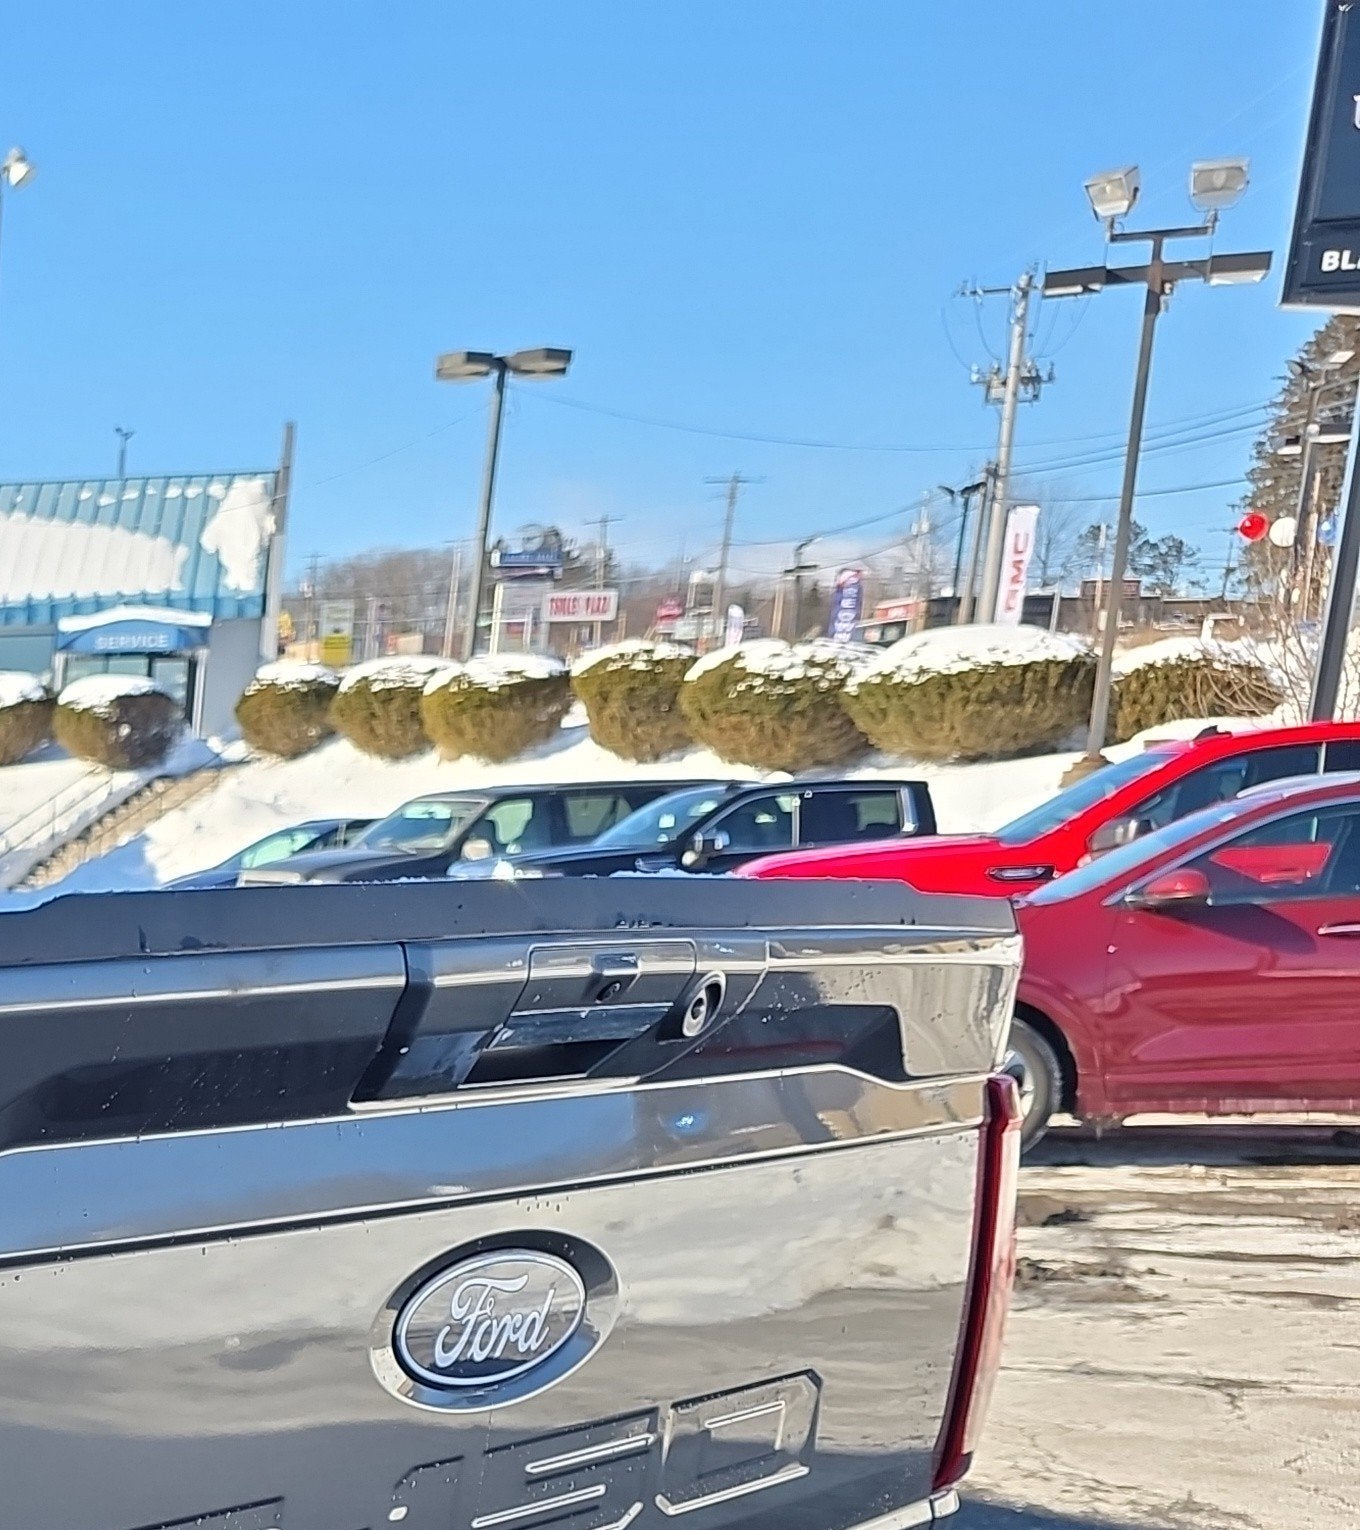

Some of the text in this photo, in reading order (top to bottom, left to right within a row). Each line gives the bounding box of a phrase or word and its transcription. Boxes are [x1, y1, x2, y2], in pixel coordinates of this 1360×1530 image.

[1321, 249, 1360, 272] BL
[94, 634, 169, 650] SERVICE
[434, 1274, 556, 1368] Ford
